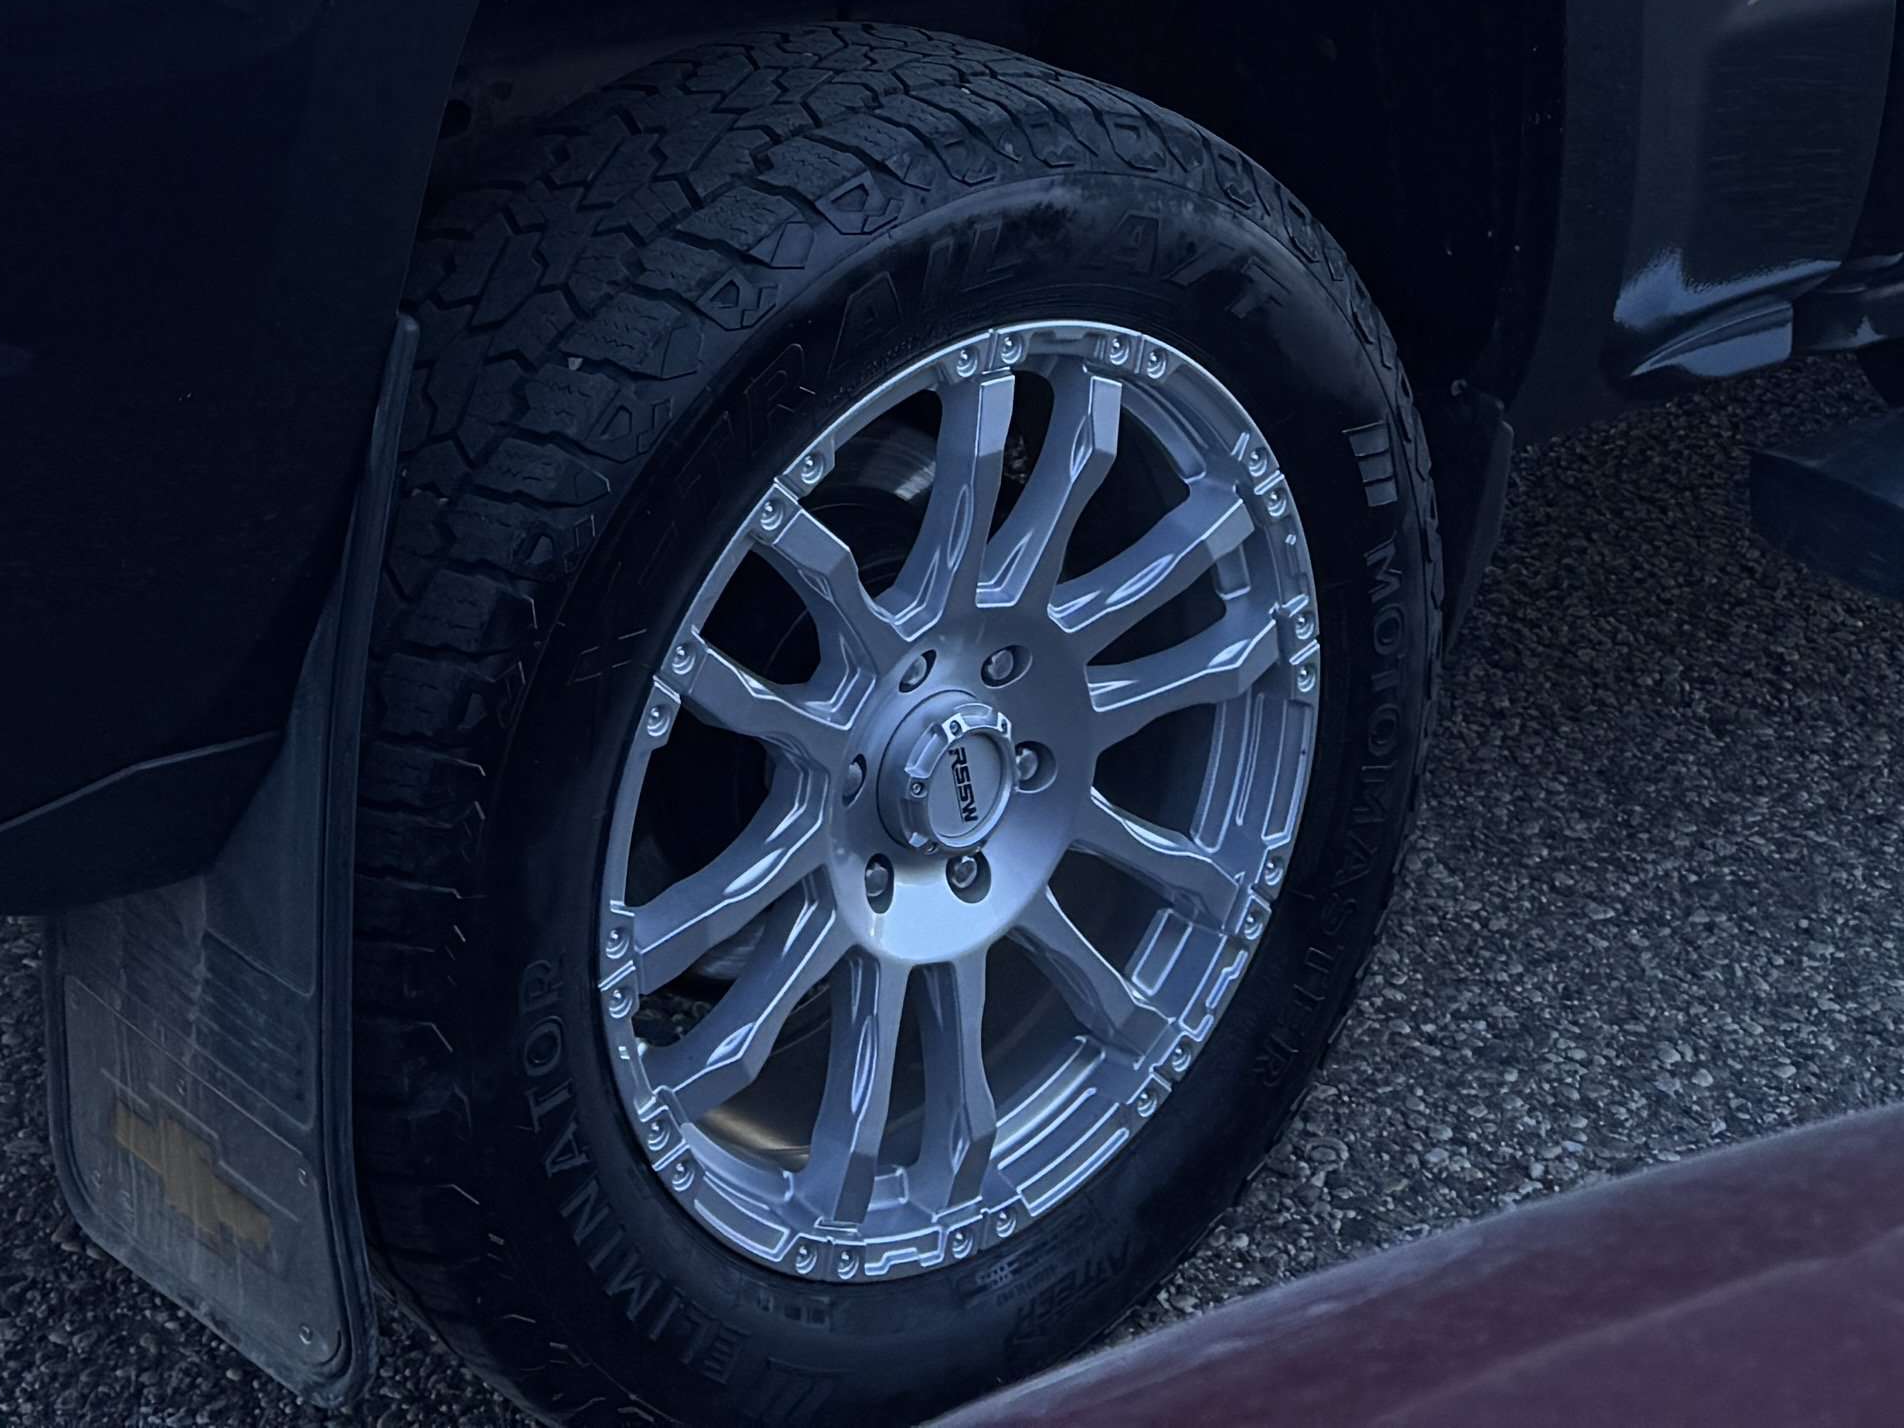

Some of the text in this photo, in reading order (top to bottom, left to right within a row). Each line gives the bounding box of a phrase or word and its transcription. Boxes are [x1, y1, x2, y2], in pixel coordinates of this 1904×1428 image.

[949, 746, 979, 824] RSSW
[1260, 534, 1404, 1091] MOTOMASTER
[521, 957, 752, 1385] ELIMINATOR
